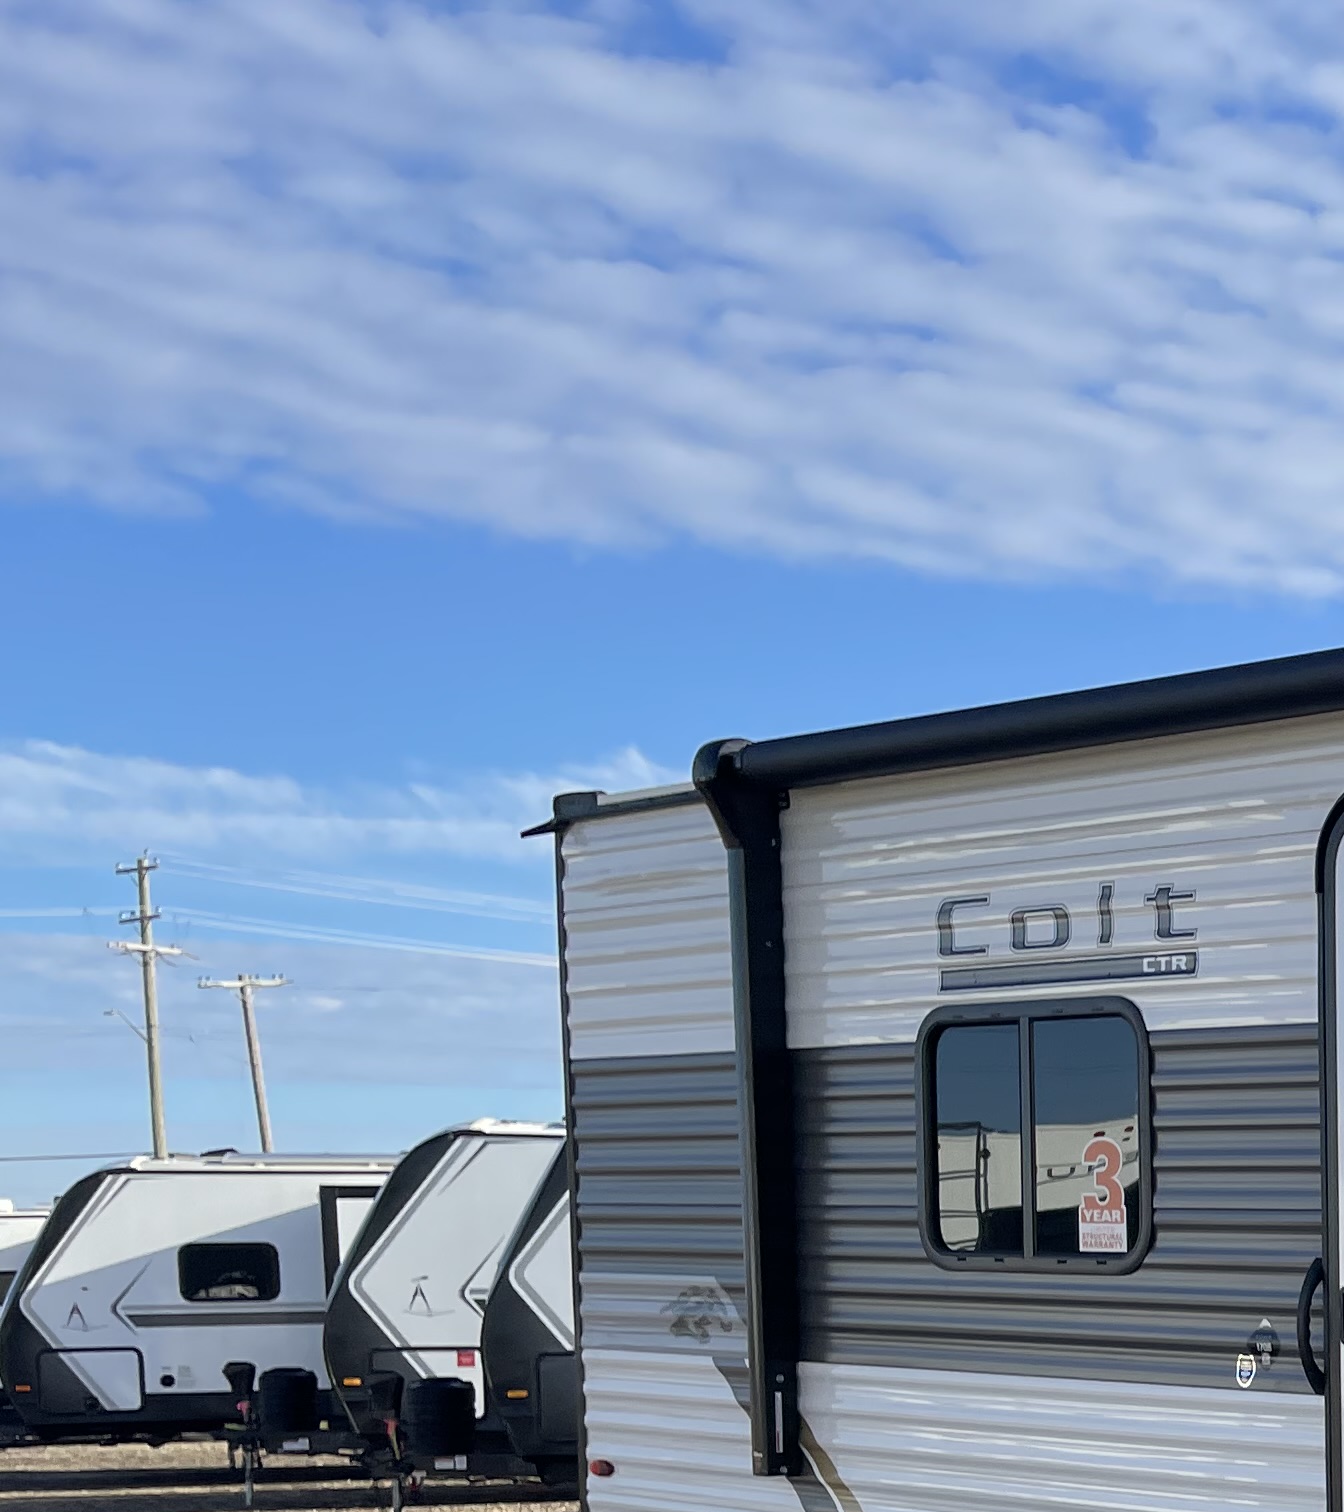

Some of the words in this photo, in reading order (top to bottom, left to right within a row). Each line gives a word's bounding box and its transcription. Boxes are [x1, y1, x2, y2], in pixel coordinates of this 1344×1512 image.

[937, 881, 1197, 957] Colt
[1143, 955, 1187, 973] CTR
[1082, 1138, 1124, 1210] 3
[1083, 1209, 1121, 1222] YEAR
